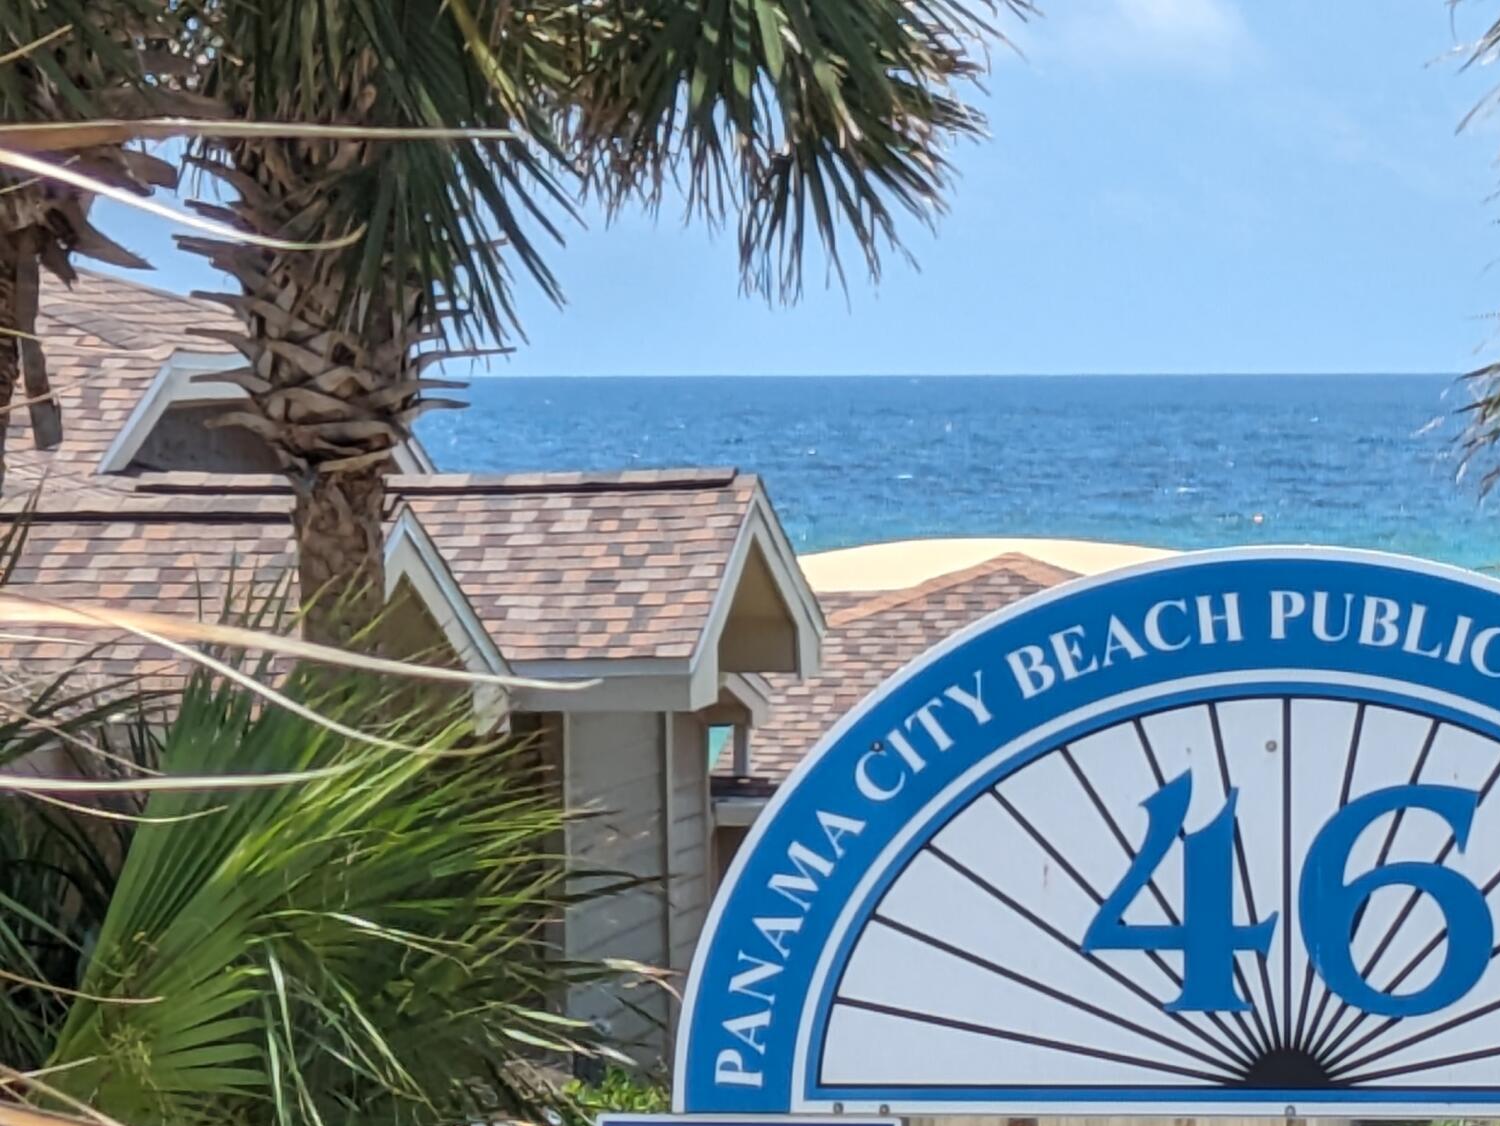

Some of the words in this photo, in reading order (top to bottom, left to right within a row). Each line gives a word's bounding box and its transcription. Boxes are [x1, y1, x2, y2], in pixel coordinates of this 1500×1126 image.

[715, 810, 866, 1088] PANAMA
[854, 671, 995, 801] CITY
[1006, 592, 1243, 700] BEACH
[1082, 767, 1494, 1018] 46
